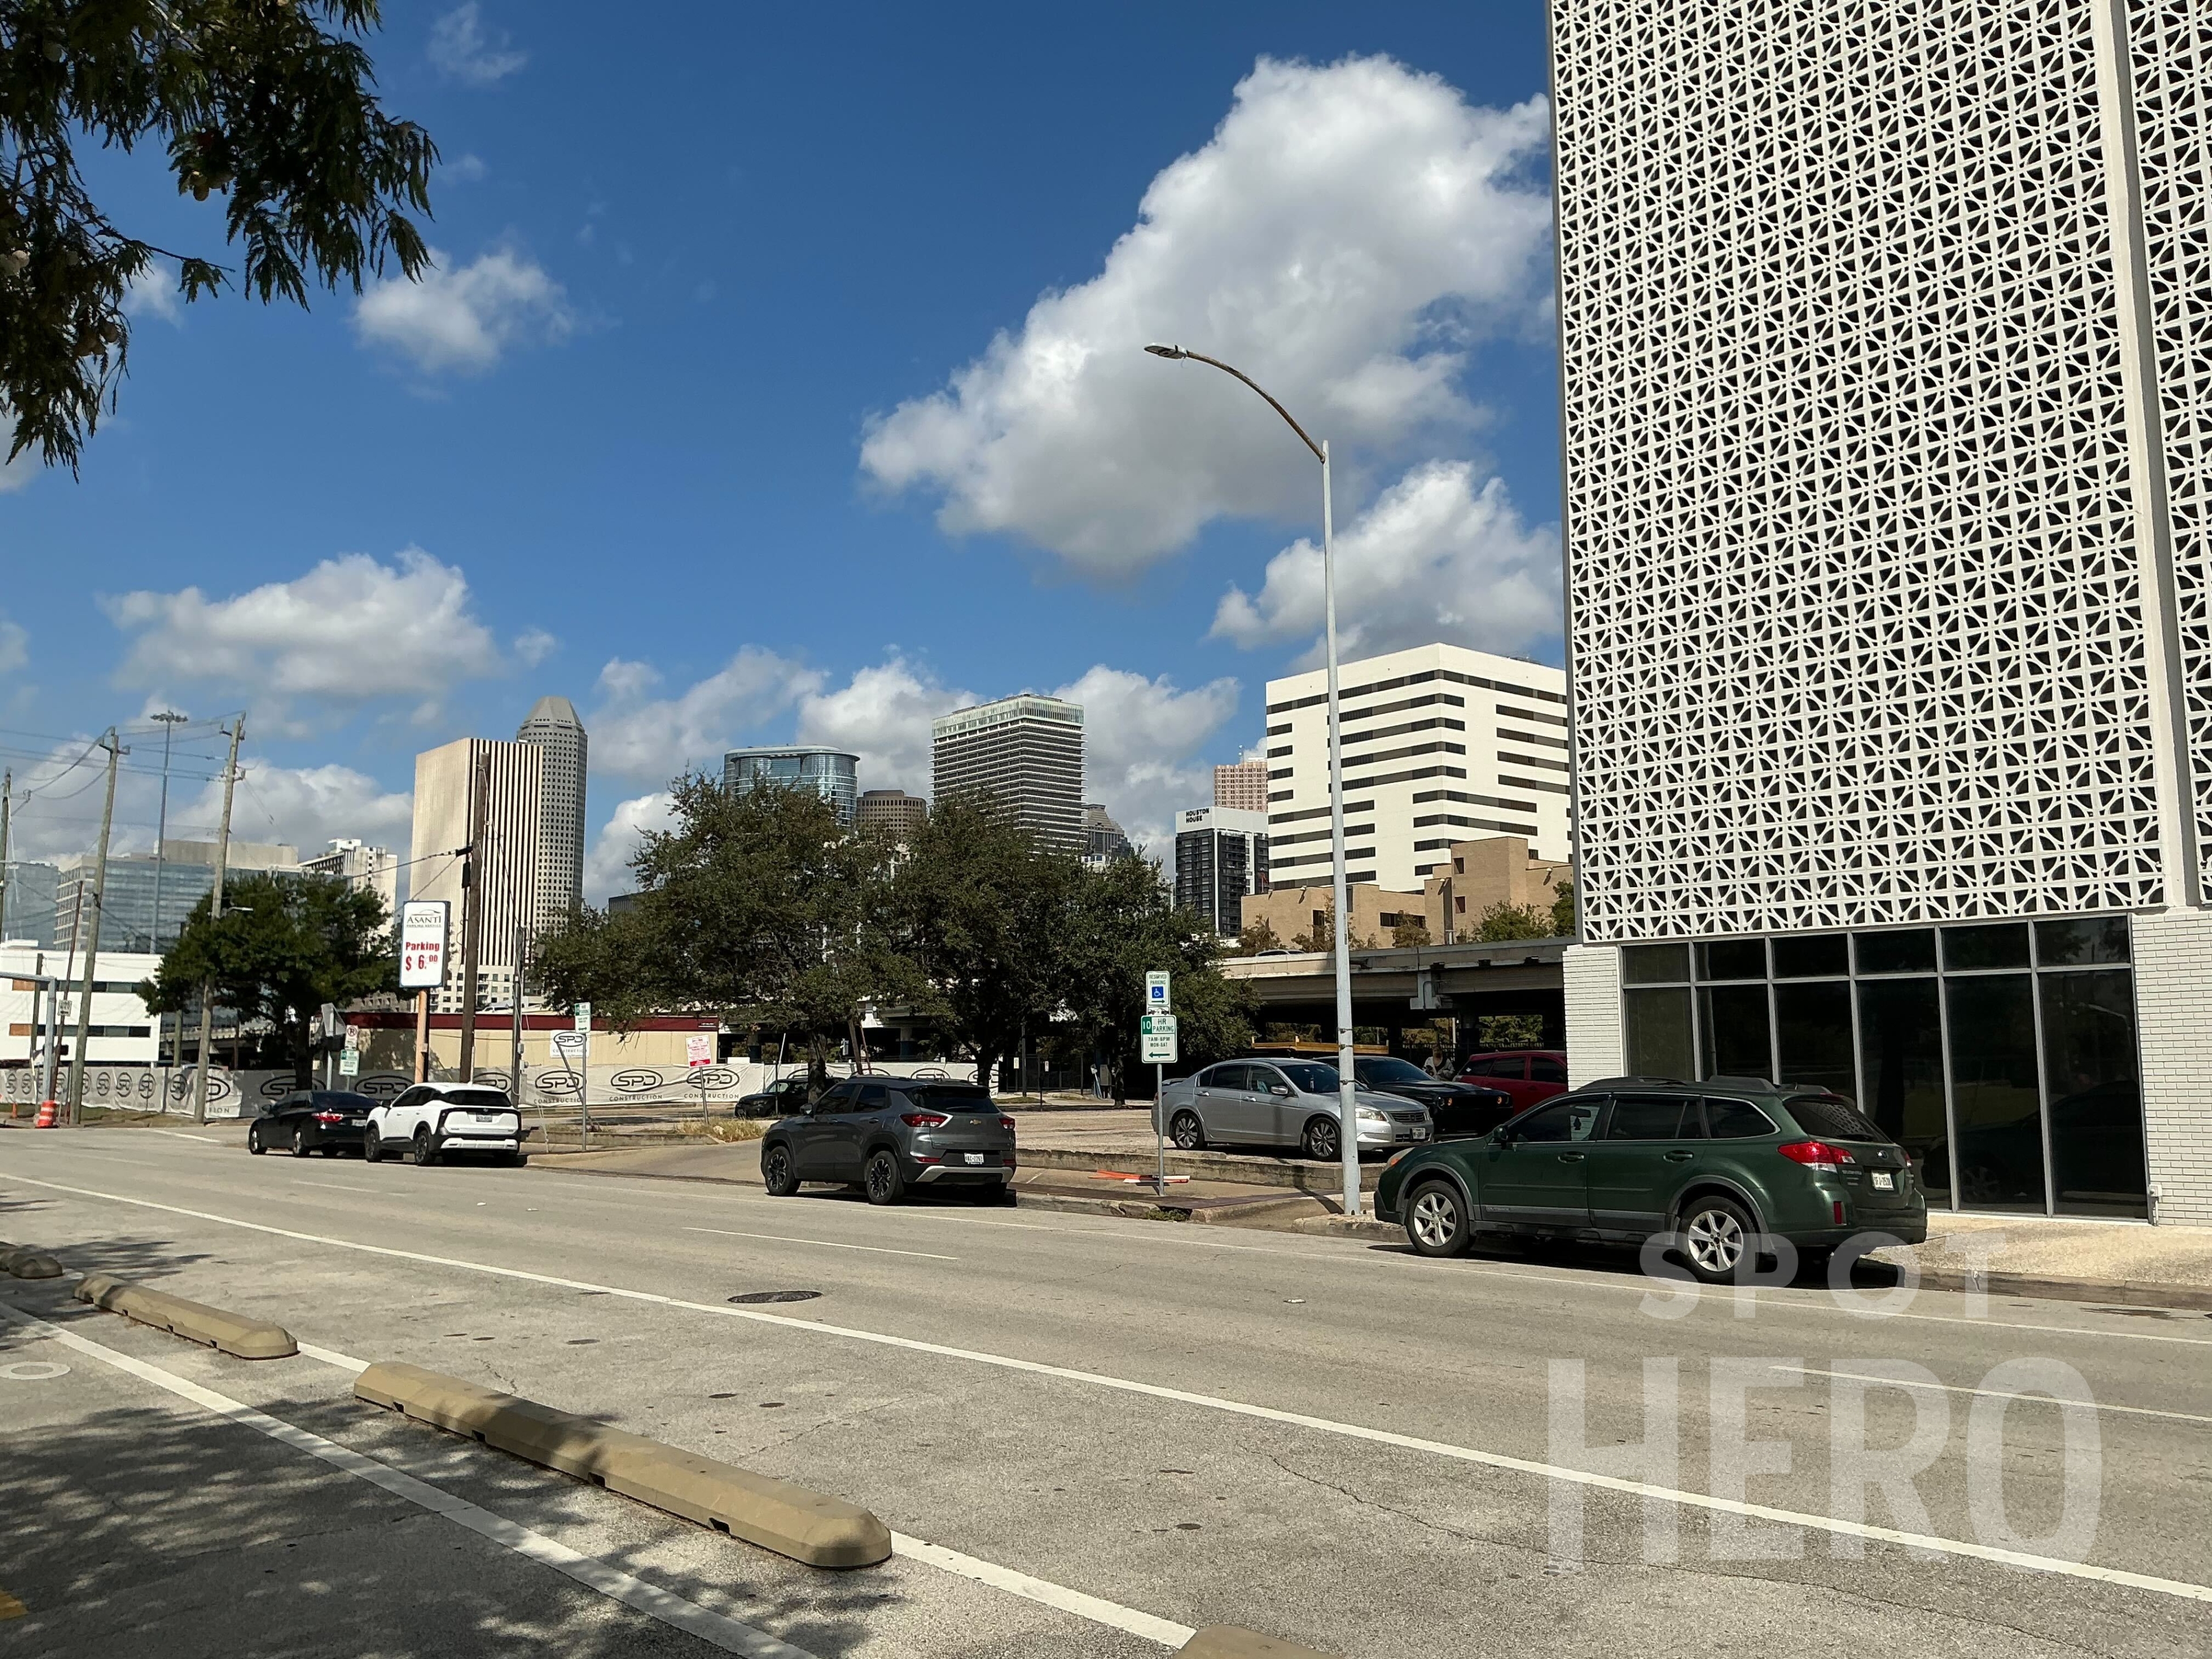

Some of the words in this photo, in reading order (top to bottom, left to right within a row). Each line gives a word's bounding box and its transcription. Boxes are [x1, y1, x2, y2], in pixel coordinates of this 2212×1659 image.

[1186, 808, 1209, 817] HOUSTON
[1186, 815, 1202, 823] HOUSE
[406, 942, 440, 951] Parking
[406, 955, 412, 971] $
[1143, 1021, 1151, 1029] 10
